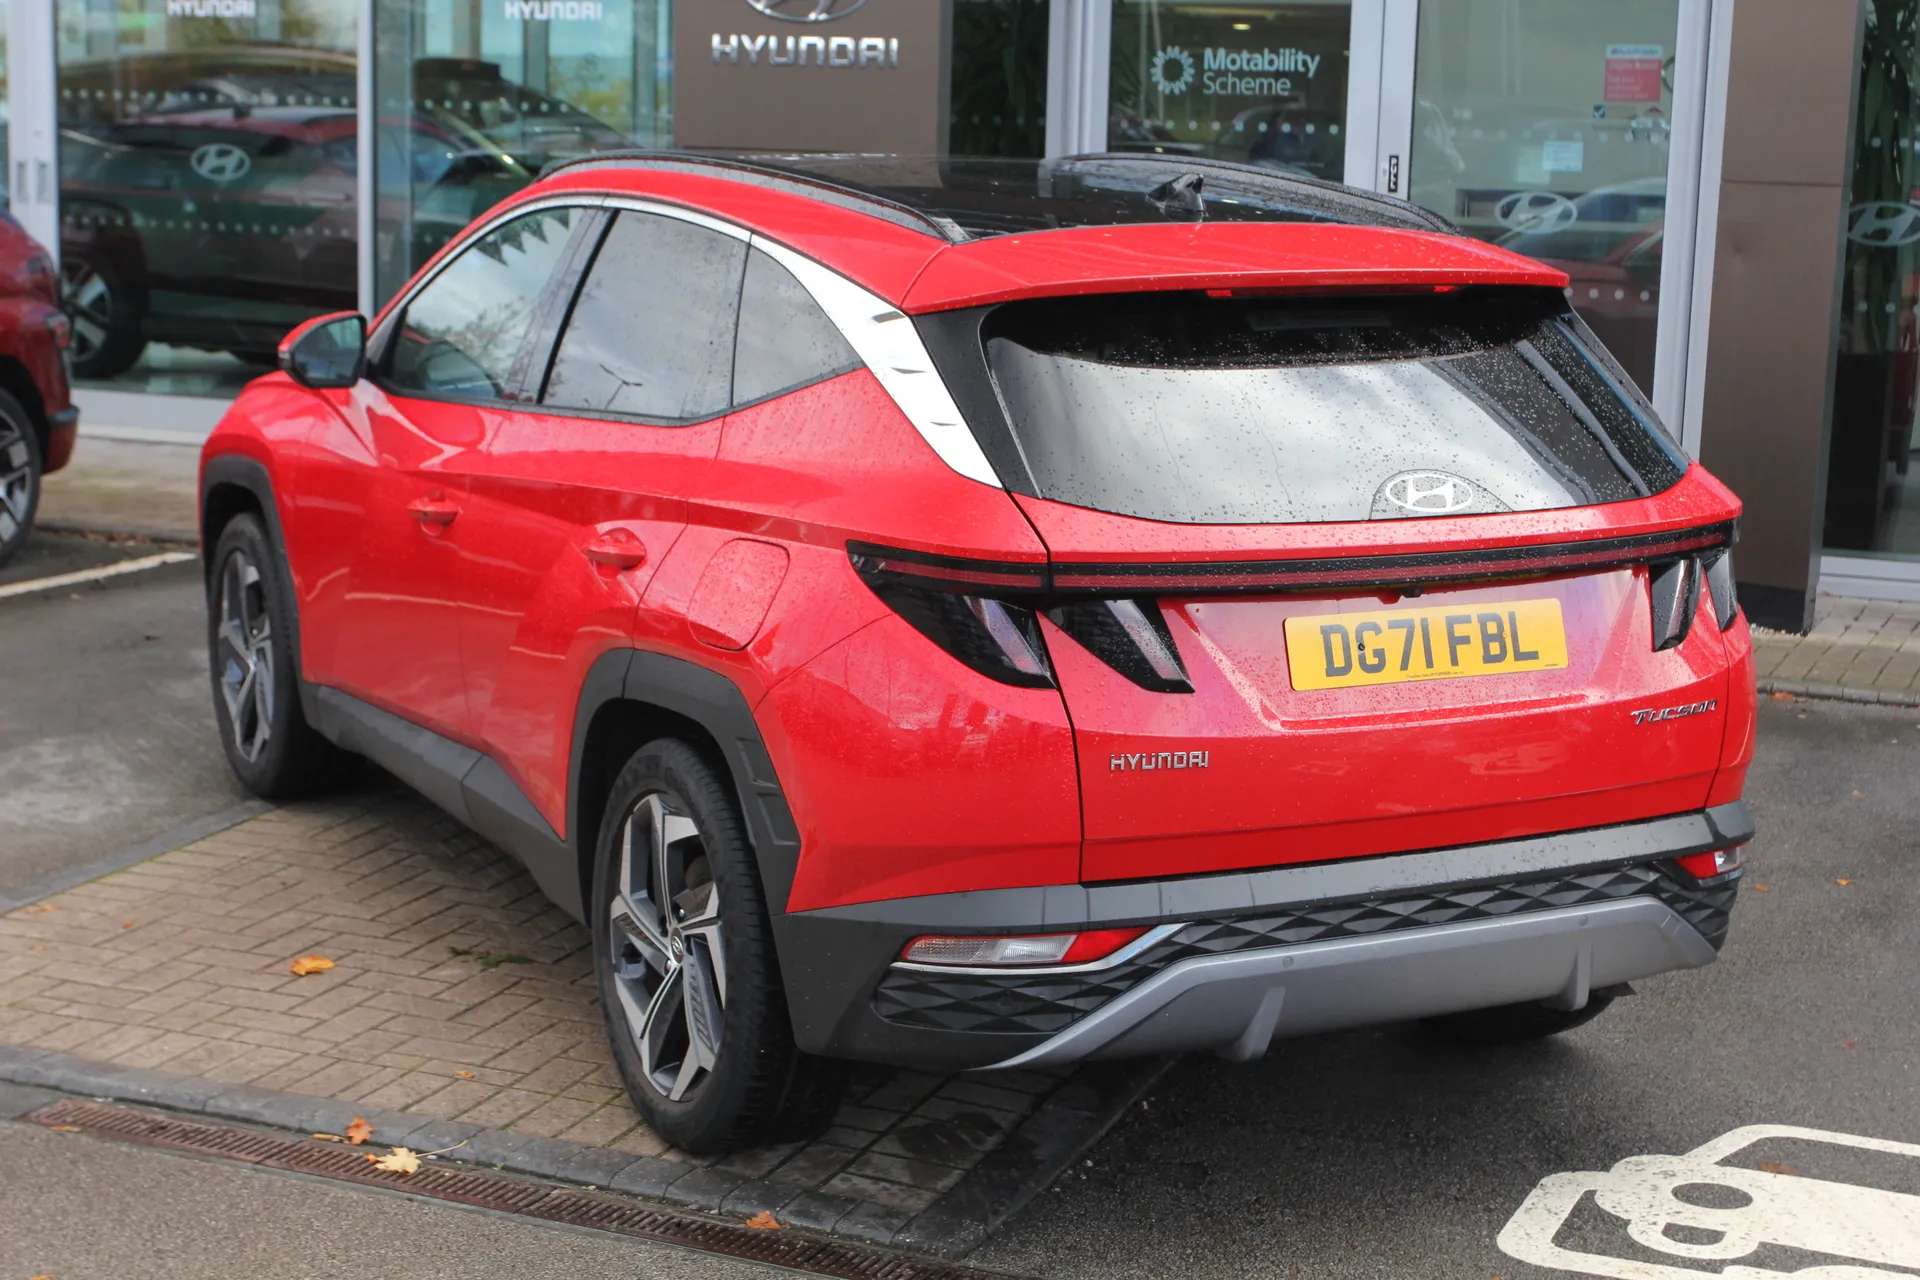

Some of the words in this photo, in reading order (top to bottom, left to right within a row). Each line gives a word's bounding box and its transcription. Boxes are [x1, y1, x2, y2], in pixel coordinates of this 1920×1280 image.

[167, 0, 257, 18] HYUNDAI
[504, 0, 604, 20] HYUNDAI
[711, 33, 899, 66] HYUNDAI
[1203, 47, 1321, 79] Motability
[1203, 72, 1291, 96] Scheme
[1320, 617, 1434, 677] DG71
[1445, 611, 1540, 667] FBL
[1110, 751, 1209, 771] HYUNDAI
